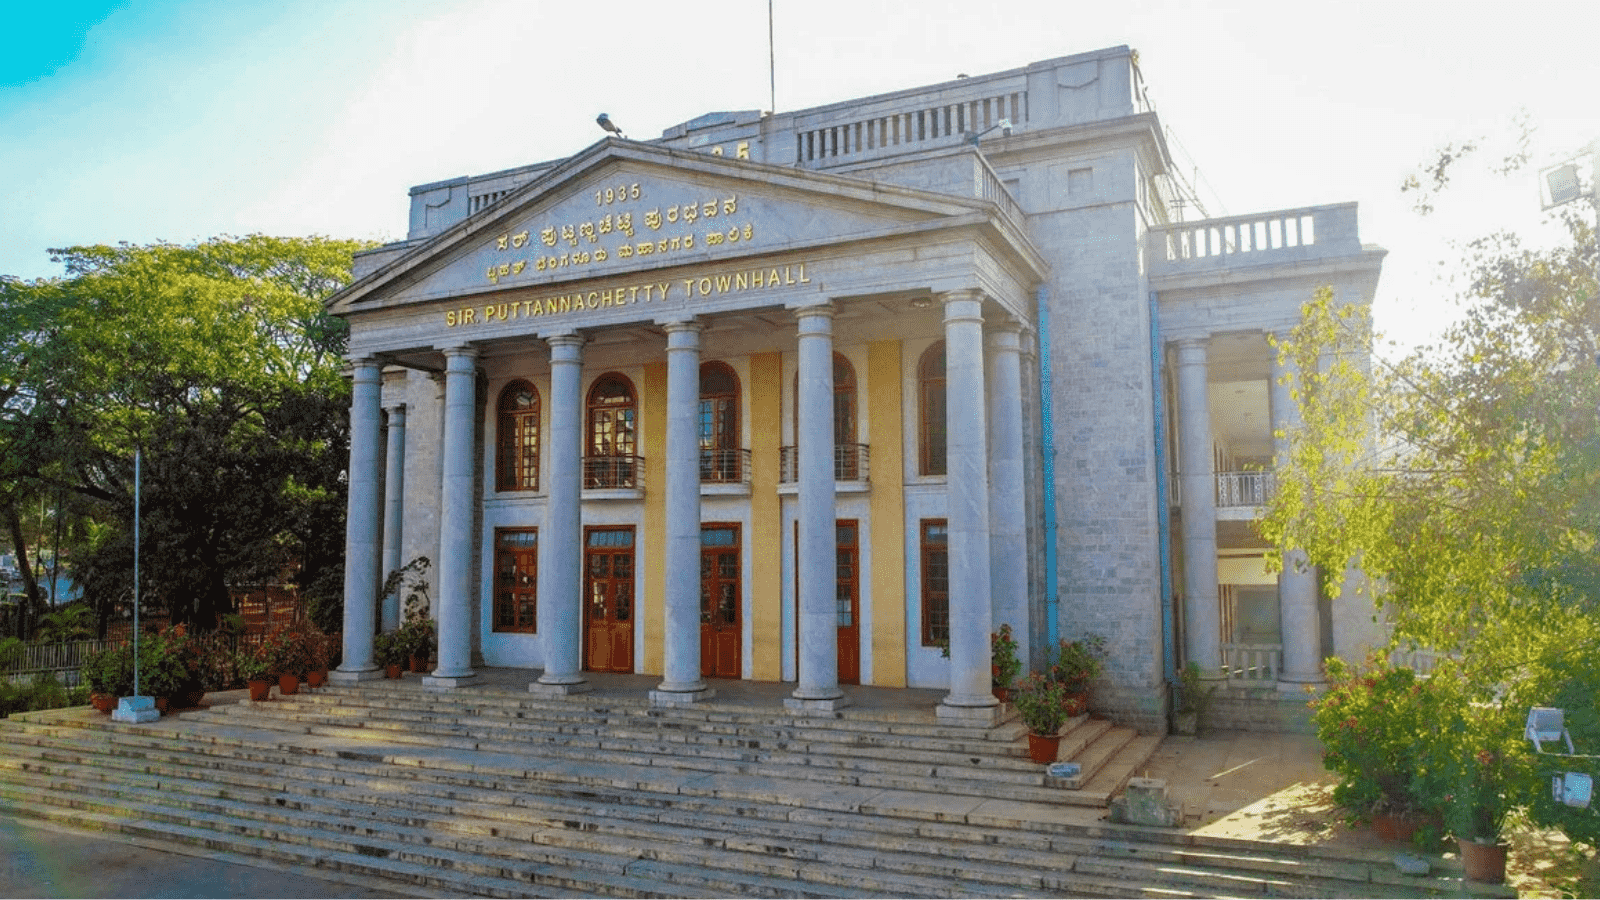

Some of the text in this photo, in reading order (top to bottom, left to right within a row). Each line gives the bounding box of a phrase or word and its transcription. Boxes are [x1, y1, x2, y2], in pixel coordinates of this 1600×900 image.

[596, 183, 640, 206] 1935
[644, 194, 737, 230] ಪುರಭವನ
[487, 223, 754, 284] ಬೃಹತ್ ಬೆಂಗಳೂರು ಮಹಾನಗರ ಪಾಲಿಕೆ
[446, 264, 811, 328] SIR. PUTTANNACHETTY TOWNHALL
